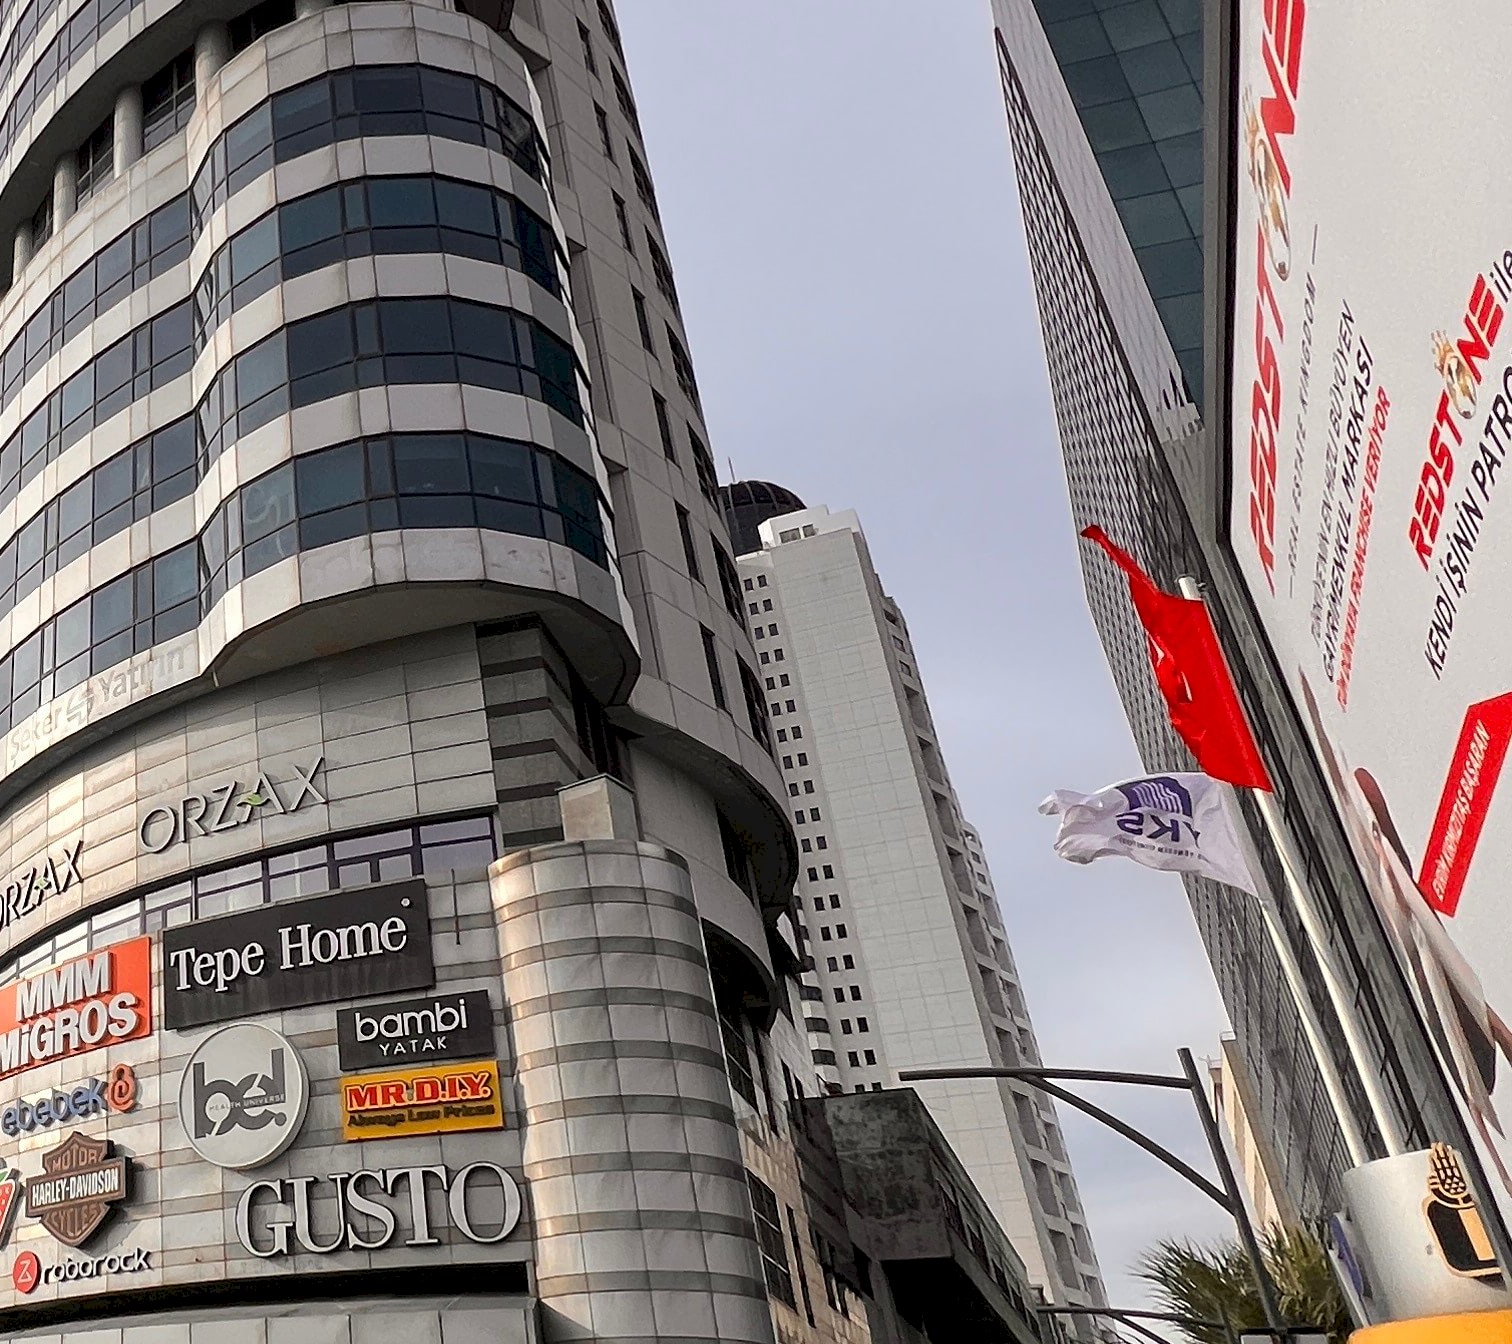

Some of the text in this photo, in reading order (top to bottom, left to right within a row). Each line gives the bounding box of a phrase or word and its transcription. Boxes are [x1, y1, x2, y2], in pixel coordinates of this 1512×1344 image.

[1330, 302, 1353, 438] BÜYÜYEN
[1342, 338, 1373, 502] MARKASI
[1366, 386, 1389, 493] VERİYOR
[1439, 487, 1484, 599] İŞİNİN
[1425, 575, 1457, 681] KENDİ
[139, 756, 328, 854] ORZAX
[16, 951, 113, 1022] MMM
[170, 916, 406, 992] Tepe Home
[355, 998, 468, 1042] bambi
[379, 1036, 447, 1057] YATAK
[1, 1077, 109, 1136] ebebek
[31, 1167, 119, 1207] HARLEY-DAVIDSON
[52, 1143, 98, 1170] MOTOR
[236, 1160, 521, 1258] GUSTO
[40, 1248, 151, 1284] roborock
